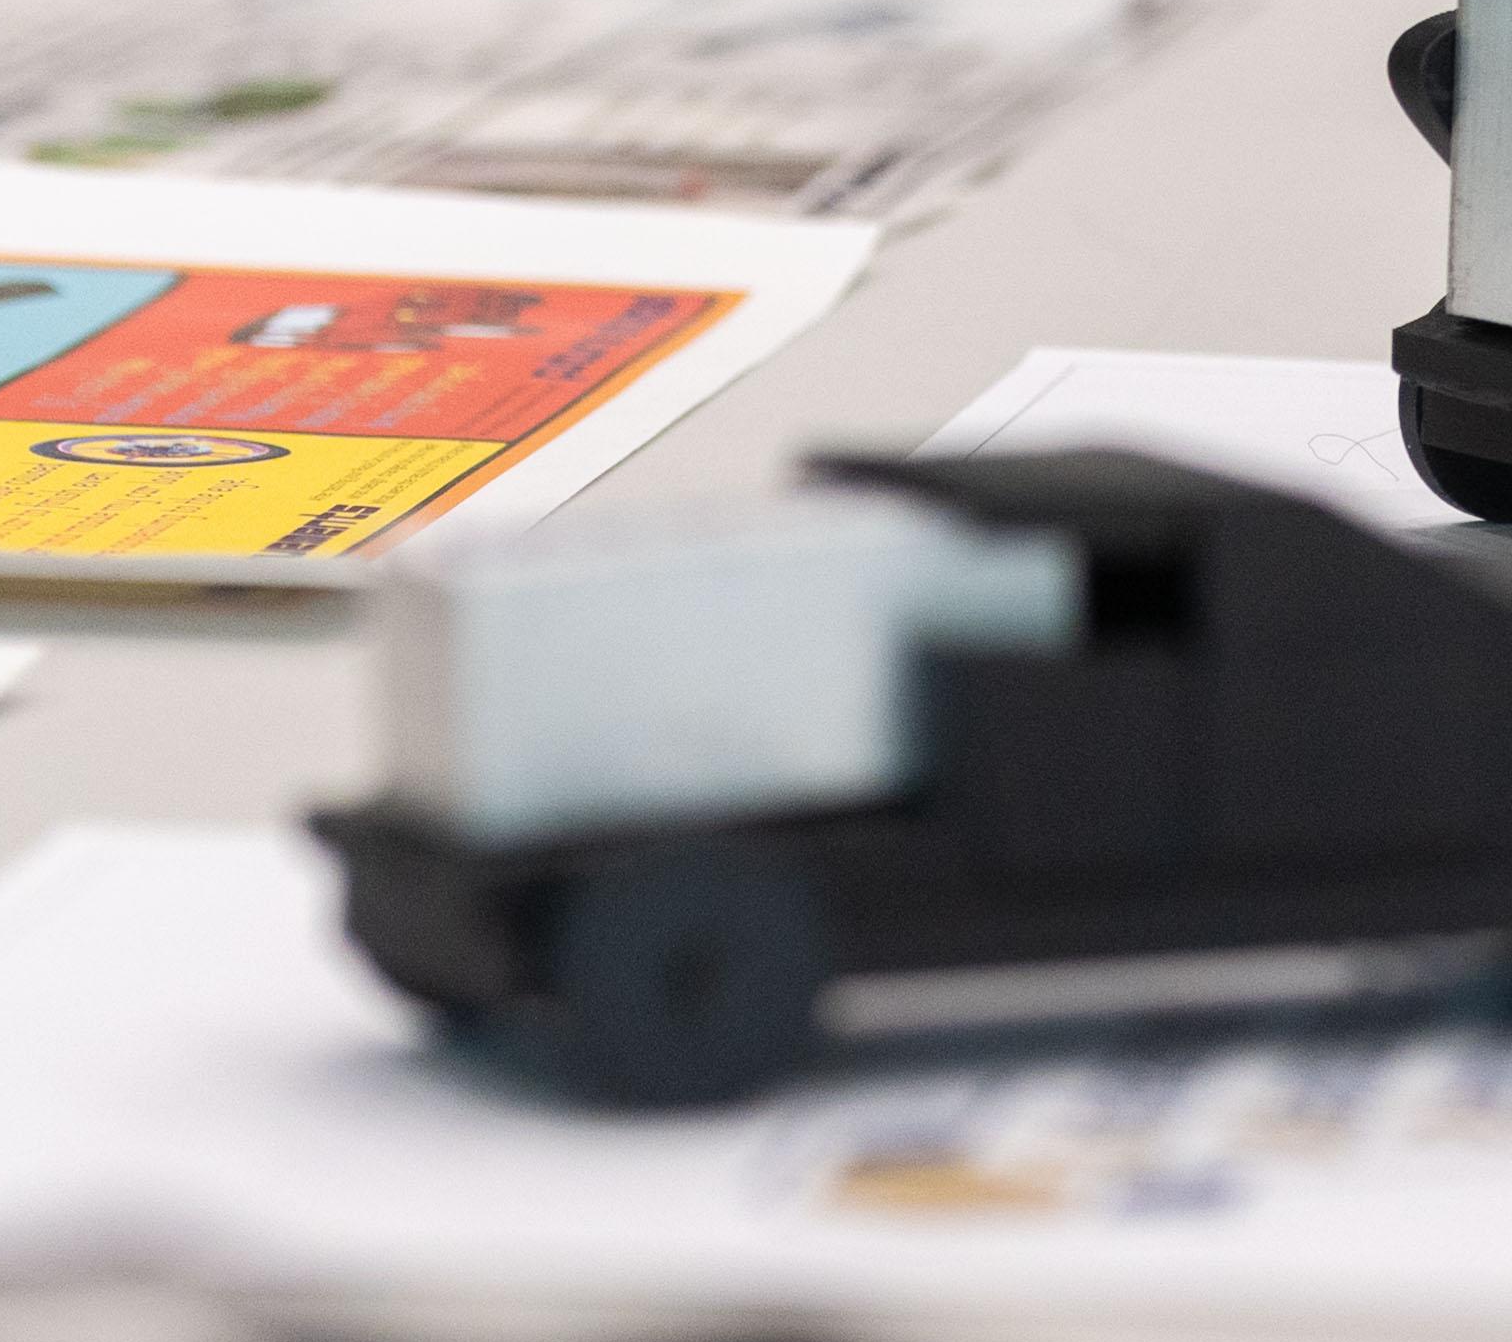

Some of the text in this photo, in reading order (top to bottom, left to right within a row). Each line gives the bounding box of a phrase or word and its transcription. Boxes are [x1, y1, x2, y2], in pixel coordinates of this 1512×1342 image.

[205, 476, 261, 493] eye.
[98, 497, 163, 512] my
[254, 503, 382, 556] vements
